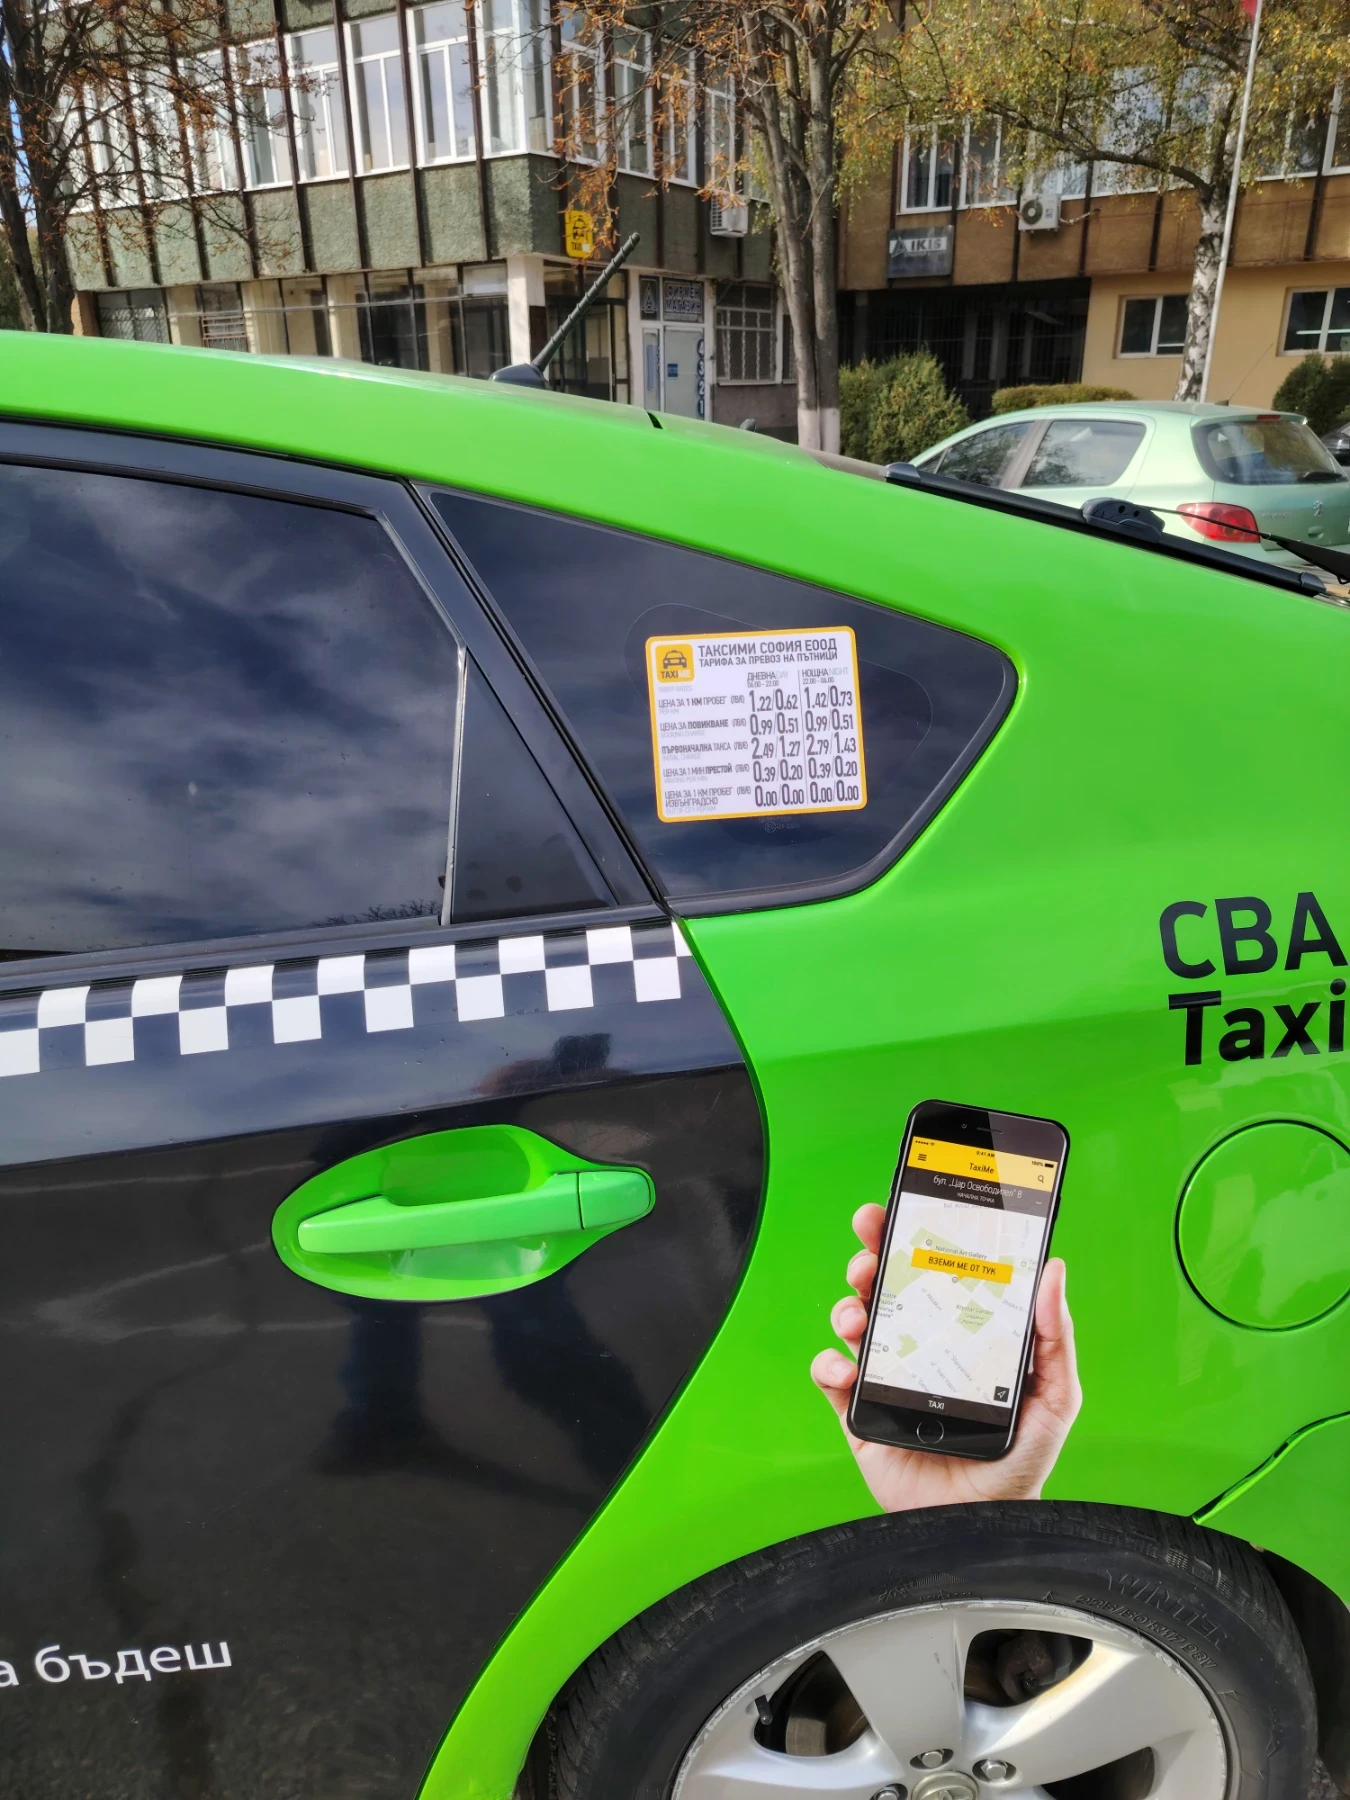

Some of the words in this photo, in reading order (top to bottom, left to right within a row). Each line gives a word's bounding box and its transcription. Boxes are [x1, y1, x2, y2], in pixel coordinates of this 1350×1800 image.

[665, 299, 702, 313] МАГАЗИН
[698, 643, 756, 658] ТАКСИМИ
[760, 640, 802, 655] СОФИЯ
[805, 638, 838, 652] ЕООД
[699, 656, 734, 668] ТАРИФА
[736, 655, 746, 665] ЗА
[748, 654, 781, 665] ПРЕВОЗ
[783, 653, 795, 663] НА
[796, 650, 838, 662] ПЪТНИЦИ
[747, 672, 776, 682] ДНЕВНА
[802, 668, 828, 678] НОЩНА
[828, 666, 849, 676] NIGHT
[658, 699, 676, 708] ЦЕНА
[677, 698, 684, 708] ЗА
[687, 698, 690, 706] 1
[692, 697, 702, 707] КМ
[704, 696, 727, 706] ПРОБЕГ
[660, 722, 678, 732] ЦЕНА
[678, 722, 687, 730] ЗА
[688, 718, 728, 730] ПОВИКВАНЕ
[661, 744, 712, 755] ПЪРВОНАЧАЛНА
[712, 742, 732, 752] ТАКСА
[662, 768, 678, 778] ЦЕНА
[678, 768, 687, 776] ЗА
[692, 767, 704, 776] МИН
[705, 763, 732, 774] ПРЕСТОЙ
[664, 790, 682, 800] ЦЕНА
[683, 790, 692, 798] ЗА
[697, 788, 708, 797] КМ
[709, 786, 733, 796] ПРОБЕГ
[665, 796, 718, 808] ИЗВЪНГРАДСКО
[1168, 978, 1346, 1066] Taxi
[969, 1163, 995, 1174] TaxiMe
[933, 1174, 948, 1187] бул.
[956, 1192, 979, 1202] НАЧАЛНА
[980, 1195, 995, 1204] ТОЧКА
[935, 1245, 958, 1254] National
[968, 1250, 988, 1260] Gallery
[928, 1256, 956, 1268] ВЗЕМИ
[957, 1262, 968, 1271] МЕ
[970, 1264, 980, 1273] ОТ
[982, 1266, 996, 1276] ТУК
[928, 1400, 945, 1410] TAXI
[1106, 1569, 1228, 1651] WINTER
[34, 1640, 232, 1685] бъдеш
